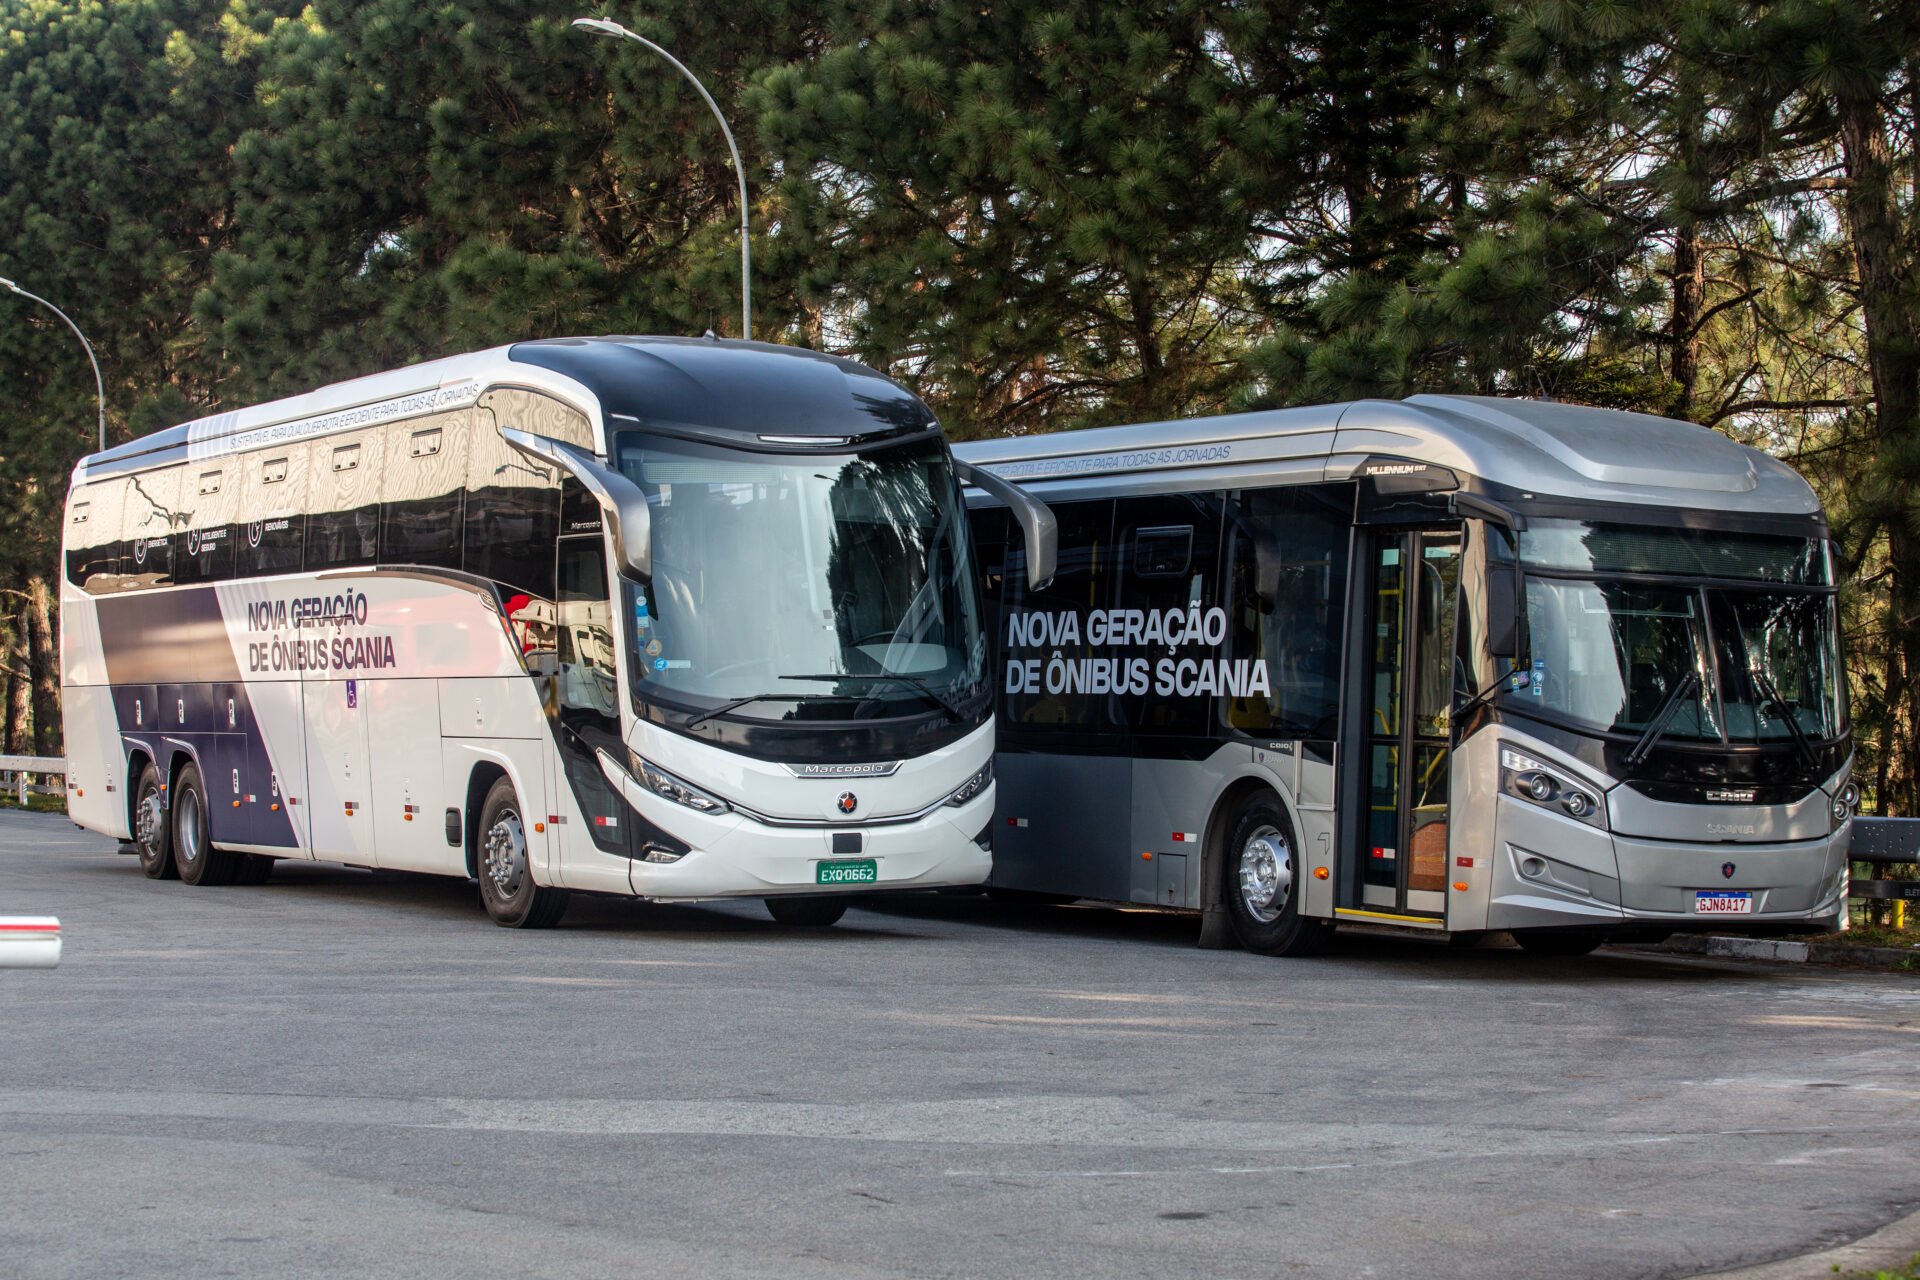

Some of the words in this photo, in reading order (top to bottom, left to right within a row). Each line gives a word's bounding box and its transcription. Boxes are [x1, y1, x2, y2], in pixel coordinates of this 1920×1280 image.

[271, 426, 287, 442] PARA
[381, 401, 399, 417] PARA
[401, 396, 424, 412] TODAS
[424, 394, 436, 408] AS
[436, 384, 479, 406] JORNADAS
[1092, 456, 1119, 469] PARA
[1122, 452, 1156, 467] TODAS
[1157, 450, 1172, 463] AS
[1172, 445, 1231, 462] JORNADAS
[571, 520, 601, 530] Marcopolo
[248, 600, 288, 631] NOVA
[291, 587, 367, 635] GERAÇÃO
[1008, 610, 1081, 647] NOVA
[1086, 600, 1227, 655] GERAÇÃO
[249, 642, 269, 672] DE
[271, 634, 329, 672] ÔNIBUS
[332, 636, 396, 670] SCANIA
[1006, 659, 1041, 694] DE
[1046, 651, 1150, 695] ÔNIBUS
[1155, 658, 1271, 698] SCANIA
[805, 764, 883, 773] Marcopolo
[1700, 898, 1746, 911] GJN8A17
